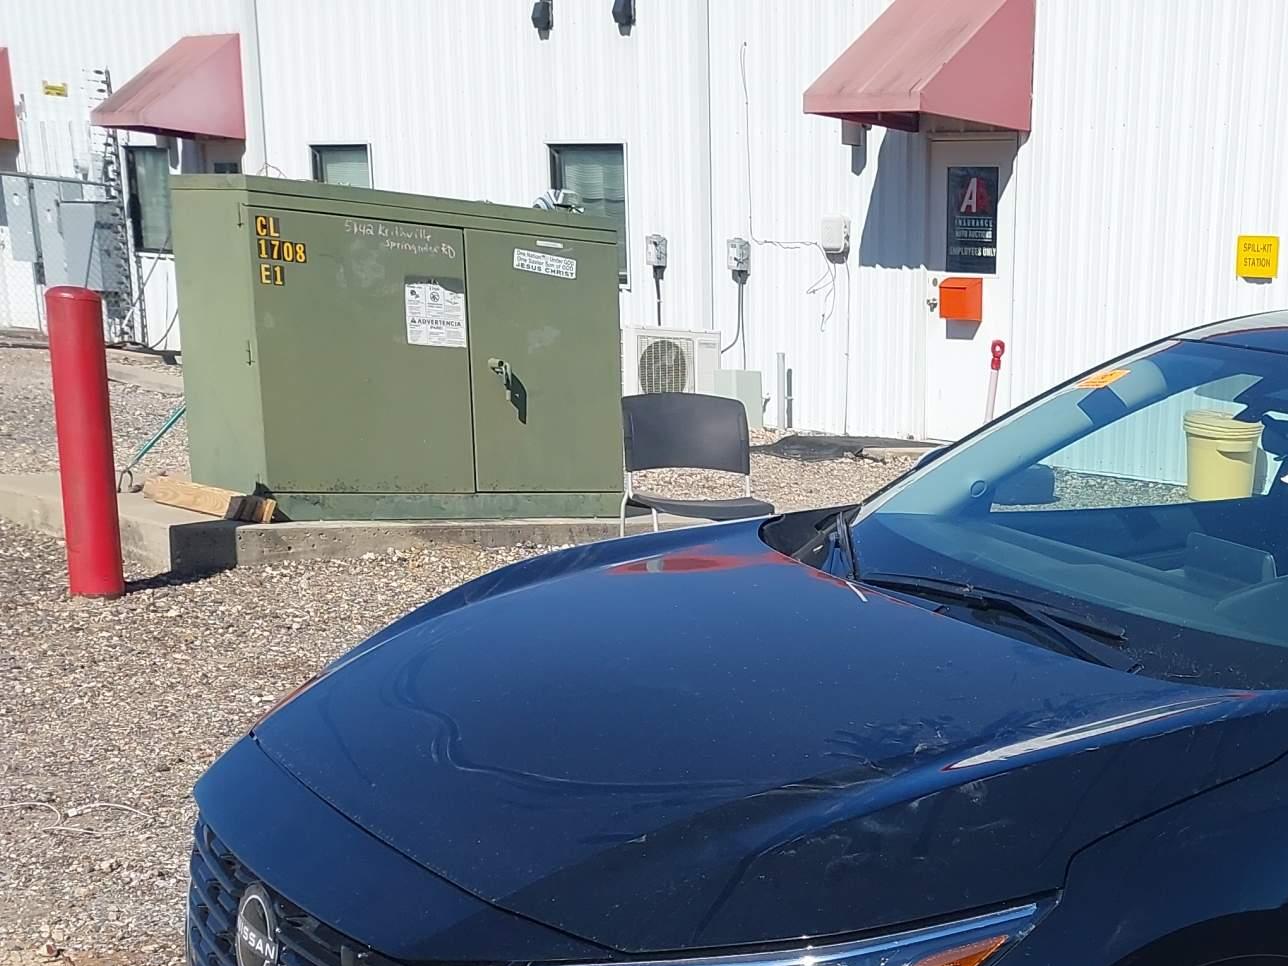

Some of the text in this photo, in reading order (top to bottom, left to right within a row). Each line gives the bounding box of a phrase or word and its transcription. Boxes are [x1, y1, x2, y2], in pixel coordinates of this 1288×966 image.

[256, 216, 280, 237] CL
[954, 219, 993, 227] INSURANCE
[258, 239, 306, 263] 1708
[982, 247, 997, 256] ONLY
[1243, 242, 1273, 253] SPILL-KIT
[1243, 257, 1271, 267] STATION
[260, 263, 283, 285] E1
[516, 263, 575, 277] JESUS CHRIST
